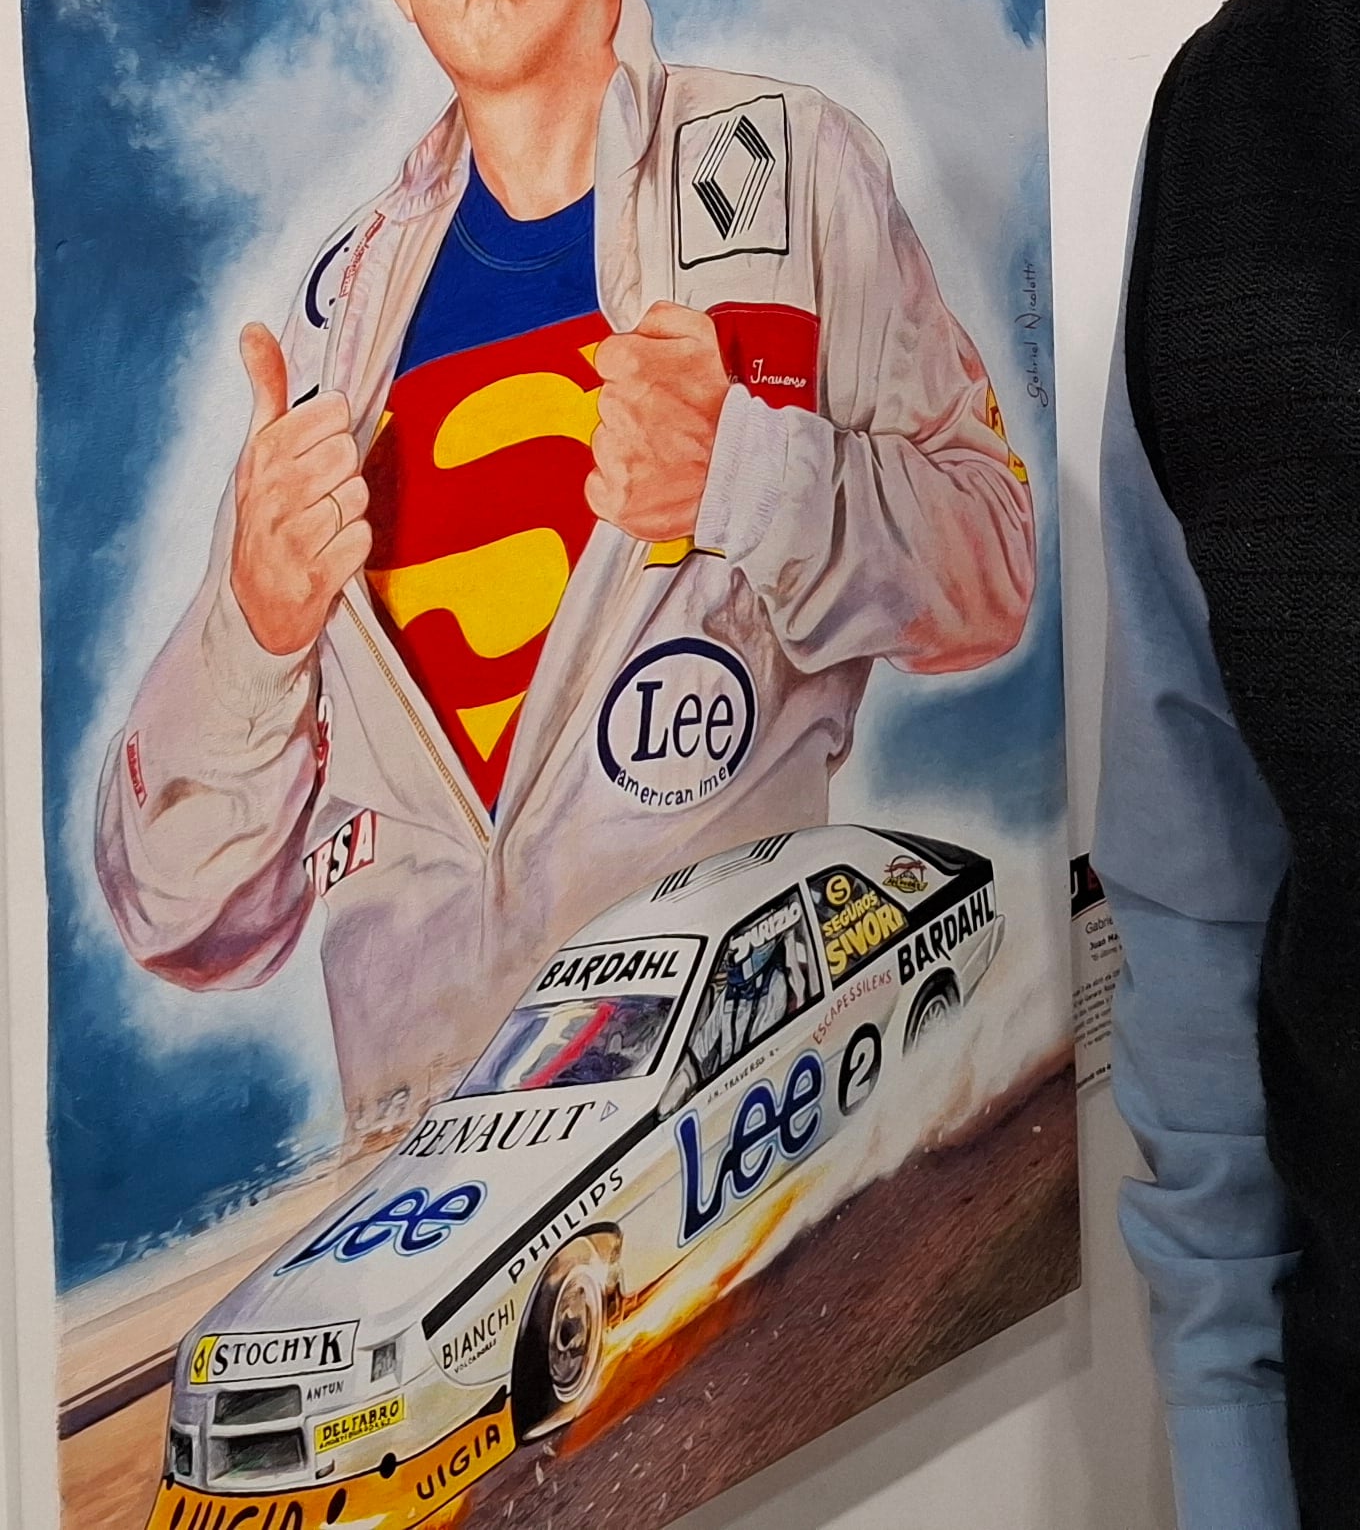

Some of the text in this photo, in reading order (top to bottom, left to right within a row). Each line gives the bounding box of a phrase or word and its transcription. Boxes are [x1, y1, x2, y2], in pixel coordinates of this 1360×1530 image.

[631, 681, 734, 761] Lee
[822, 889, 879, 937] SEGUROS
[825, 903, 906, 976] SIVORI
[897, 888, 994, 986] BARDAHL
[536, 950, 679, 991] BARDAHL
[846, 1036, 876, 1110] 2
[398, 1101, 595, 1157] RENAULT
[676, 1051, 824, 1246] Lee
[274, 1180, 488, 1276] Lee
[508, 1168, 624, 1285] PHILIPS
[212, 1330, 344, 1375] STOCHYK
[442, 1299, 515, 1369] BIANCHI
